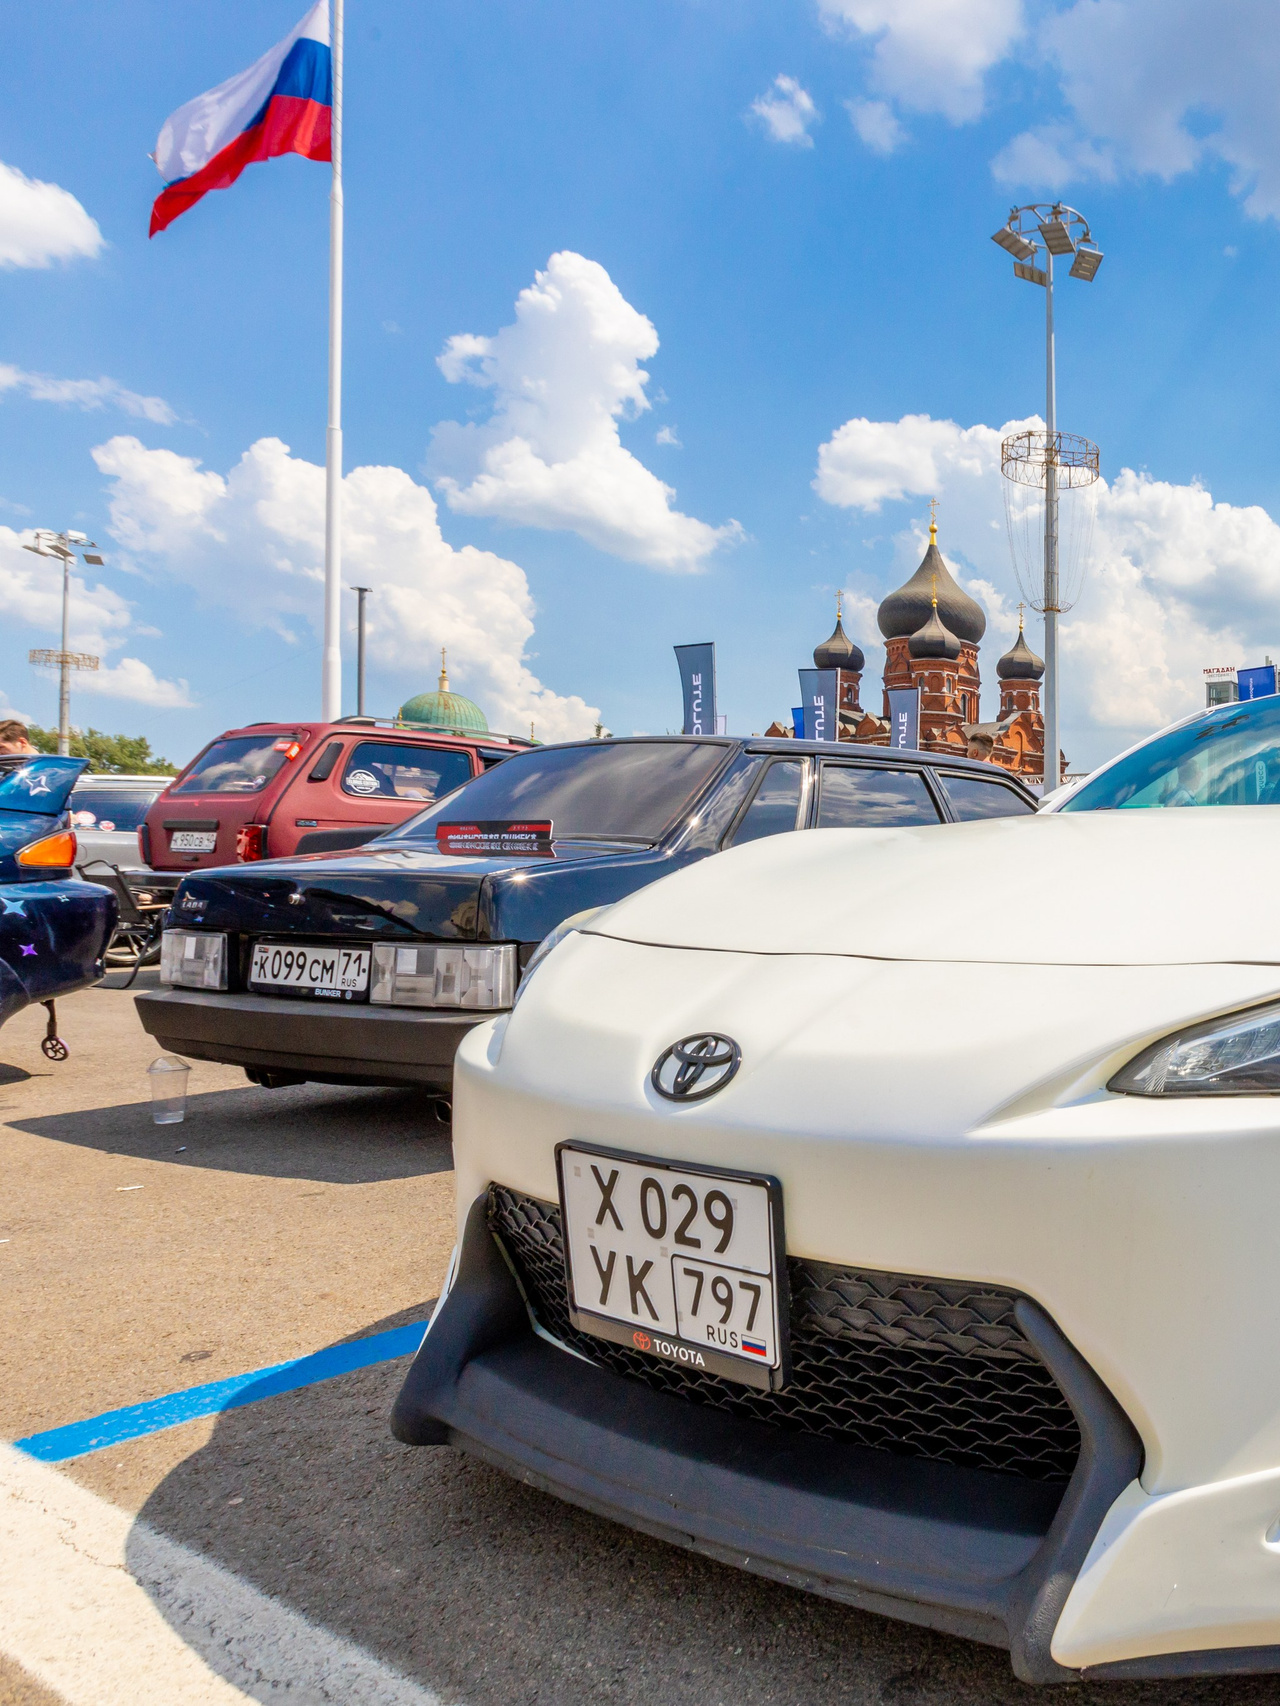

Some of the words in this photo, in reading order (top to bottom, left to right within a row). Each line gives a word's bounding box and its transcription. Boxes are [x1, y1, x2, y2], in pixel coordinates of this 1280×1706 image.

[1203, 666, 1236, 675] МАГАДАН
[342, 952, 363, 977] 71
[314, 988, 342, 998] BUNKER
[340, 977, 358, 988] RUS
[683, 1267, 762, 1332] 797
[706, 1324, 739, 1349] RUS
[653, 1338, 706, 1368] TOYOTA
